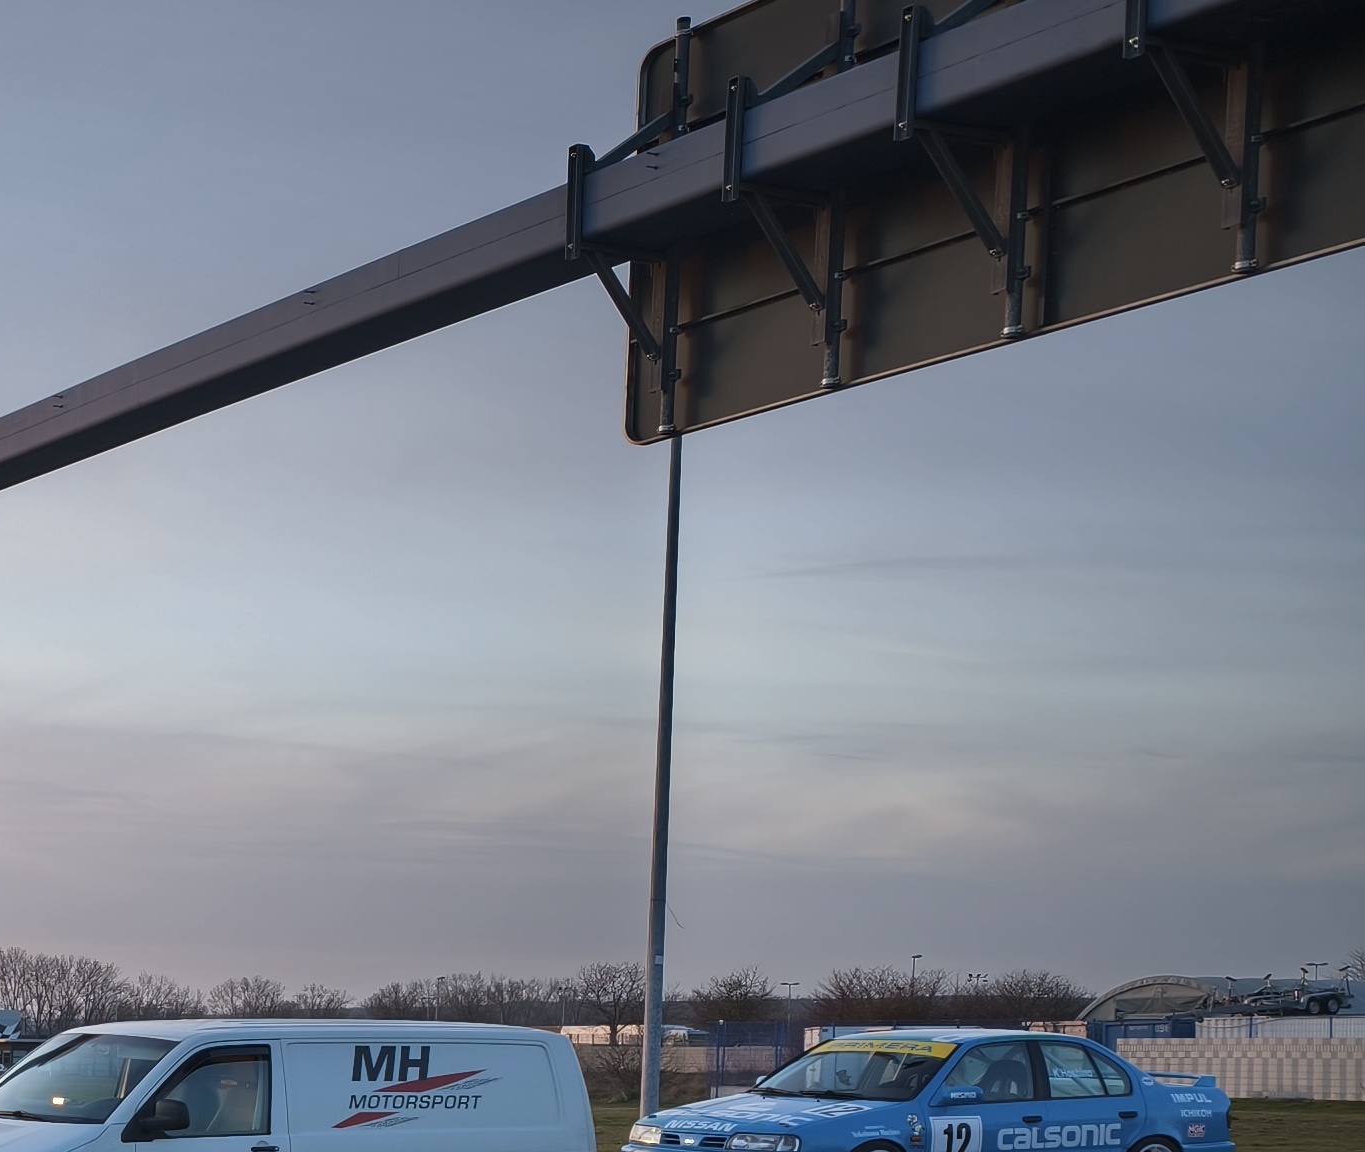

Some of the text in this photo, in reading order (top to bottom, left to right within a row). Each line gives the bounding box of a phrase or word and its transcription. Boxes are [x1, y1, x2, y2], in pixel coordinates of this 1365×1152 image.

[351, 1045, 431, 1082] MH
[349, 1094, 482, 1110] MOTORSPORT
[1171, 1093, 1213, 1103] IMPUL
[664, 1119, 738, 1132] NISSAN
